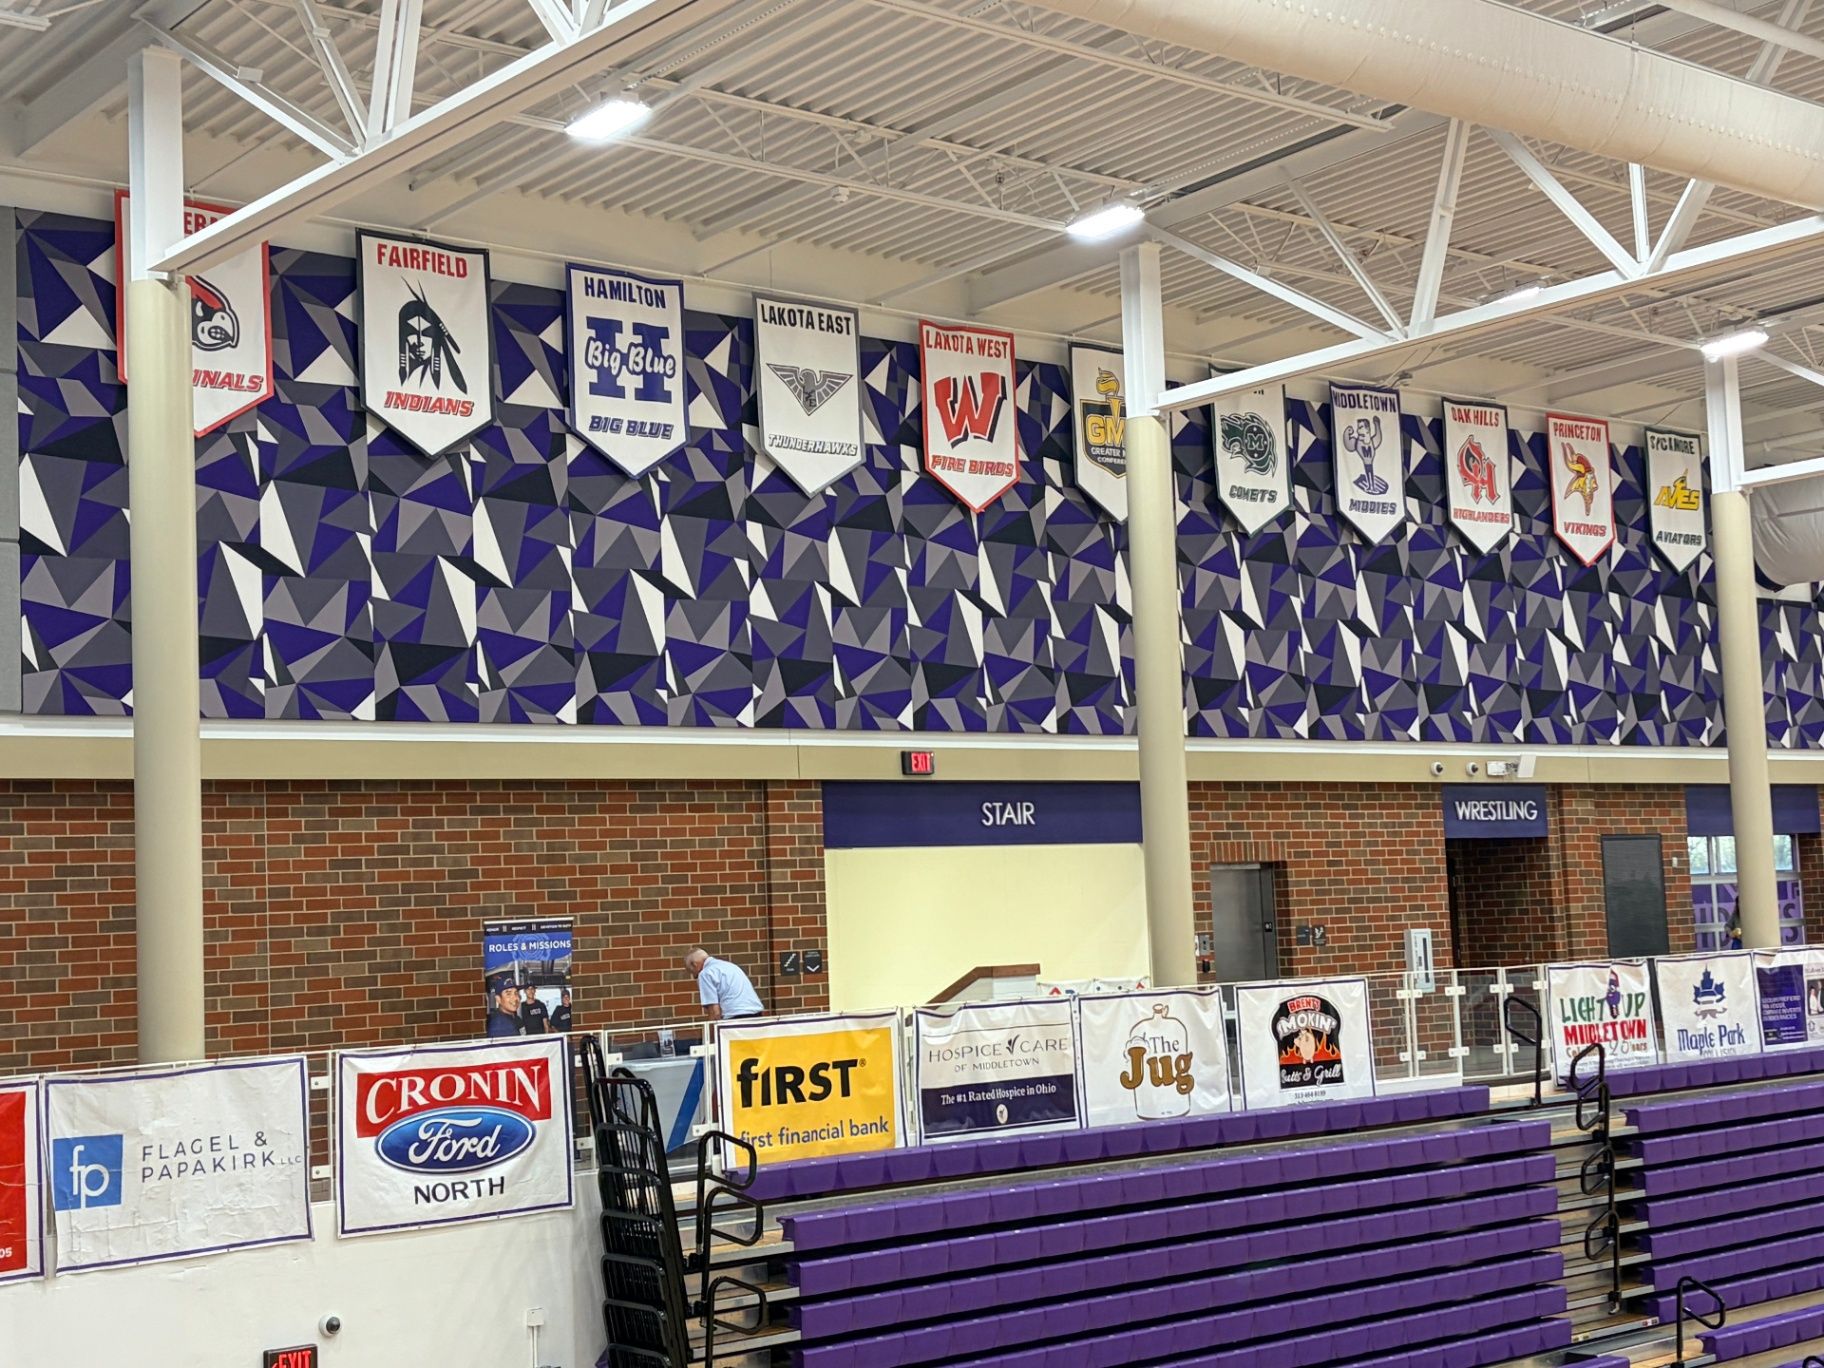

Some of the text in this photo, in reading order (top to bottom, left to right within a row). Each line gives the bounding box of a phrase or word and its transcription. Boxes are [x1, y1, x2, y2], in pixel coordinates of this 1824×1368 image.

[377, 243, 468, 278] FAIRFIELD
[584, 276, 666, 309] HAMILTON
[761, 304, 851, 335] LAKOTA EAST
[926, 330, 1008, 359] LAKOTA WEST
[585, 336, 676, 379] Big Blue
[193, 369, 263, 392] INALS
[384, 391, 474, 417] INDIANS
[933, 371, 1008, 450] W
[589, 415, 674, 440] BIG BLUE
[1451, 407, 1499, 427] OAK HILLS
[1086, 414, 1126, 447] GM
[1246, 433, 1264, 450] M
[1553, 422, 1601, 442] PRINCETON
[768, 434, 858, 457] THUNDERHAWKS
[931, 455, 1014, 478] FIRE BIRDS
[1229, 485, 1278, 503] COMETS
[1349, 499, 1397, 515] MIDDIES
[1563, 522, 1607, 537] VIKINGS
[1656, 530, 1702, 546] AVIATORS
[912, 753, 930, 772] EXIT
[981, 802, 1036, 826] STAIR
[1455, 800, 1538, 820] WRESTLING
[489, 940, 571, 952] ROLES & MISSIONS
[1560, 992, 1645, 1022] LIGHT UP
[929, 1038, 1068, 1063] HOSPICE CARE
[1149, 1036, 1180, 1054] The
[1677, 1026, 1716, 1056] Maple
[1718, 1022, 1746, 1047] Park
[954, 1058, 1039, 1073] OF MIDDLETOWN
[1120, 1046, 1195, 1095] Jug
[1314, 1064, 1341, 1087] Grill
[366, 1065, 541, 1124] CRONIN
[941, 1083, 1057, 1105] The #1 Rated Hospice in Ohio
[408, 1117, 502, 1164] Ford
[778, 1120, 844, 1145] financial
[849, 1115, 889, 1137] bank
[142, 1131, 267, 1161] FLAGEL &
[142, 1151, 275, 1183] PAPAKIRK
[414, 1176, 505, 1204] NORTH
